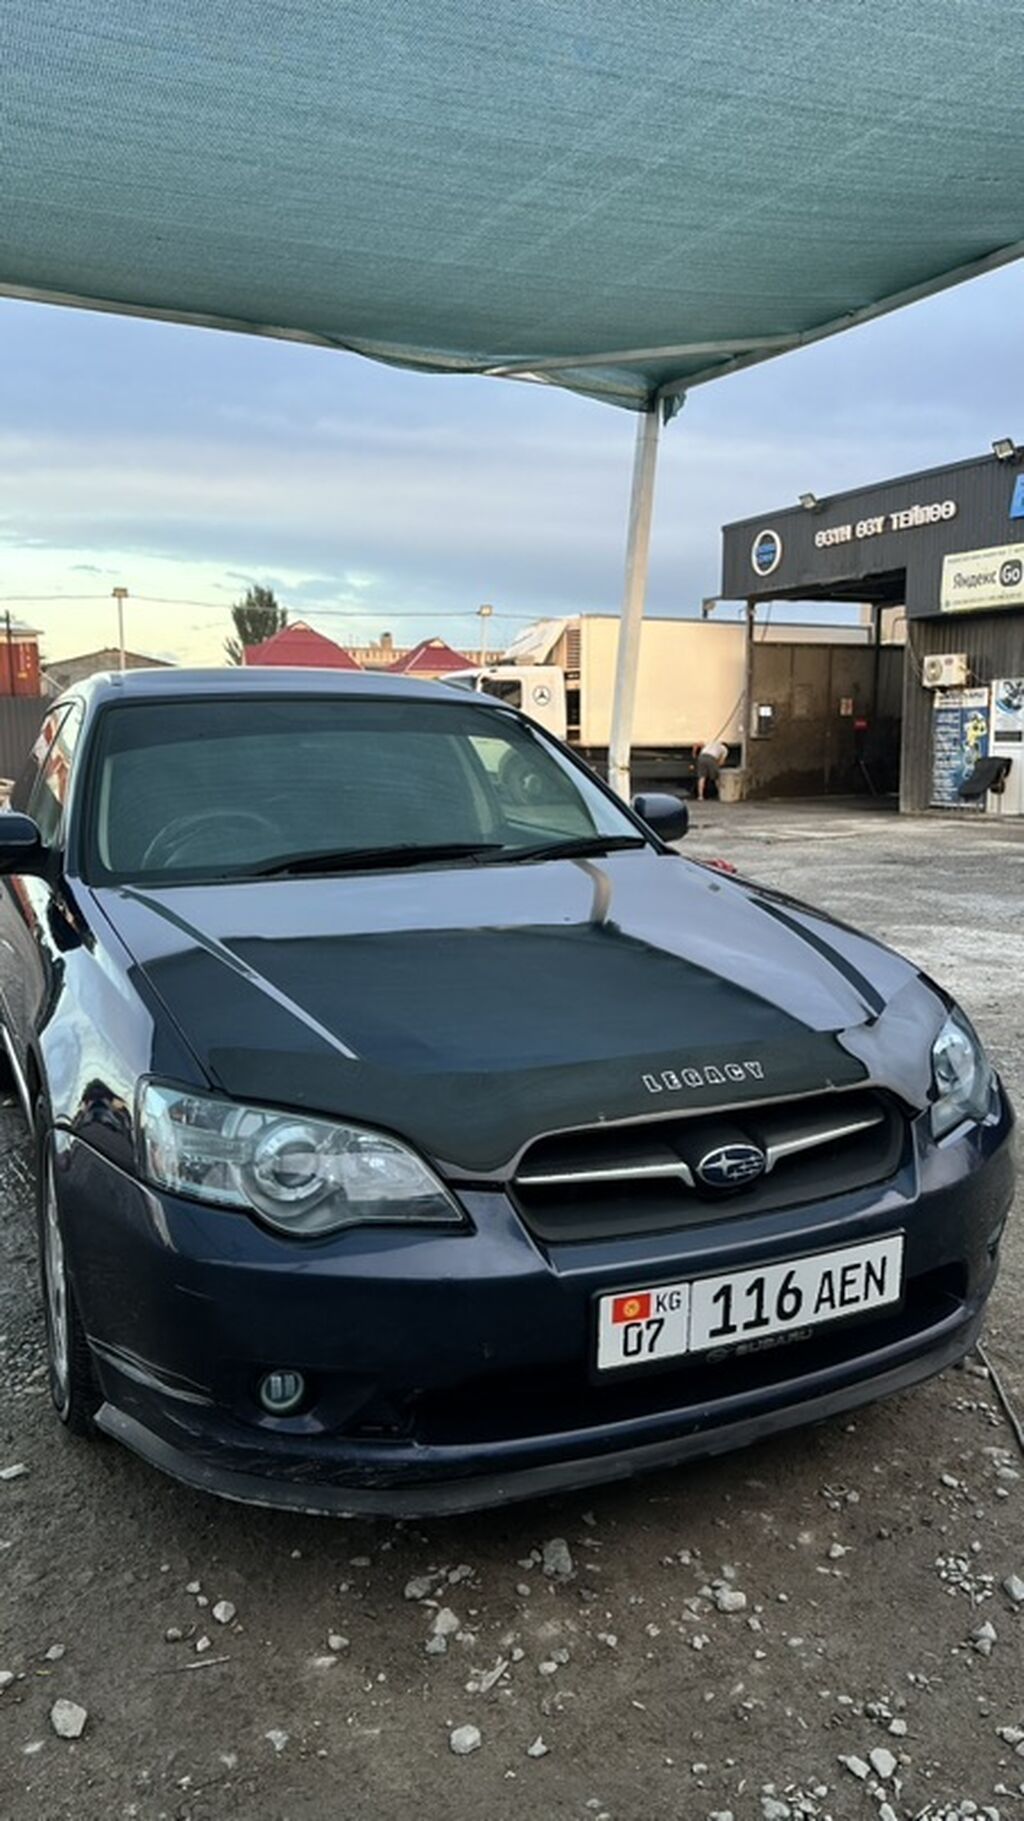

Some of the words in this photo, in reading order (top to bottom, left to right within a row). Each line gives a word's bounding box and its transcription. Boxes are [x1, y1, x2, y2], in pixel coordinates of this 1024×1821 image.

[953, 570, 997, 590] Яндекс
[1001, 564, 1021, 584] Go
[642, 1061, 765, 1093] LEGACY
[655, 1290, 683, 1314] KG
[708, 1270, 803, 1339] 116
[813, 1256, 888, 1315] AEN
[622, 1318, 666, 1358] 07
